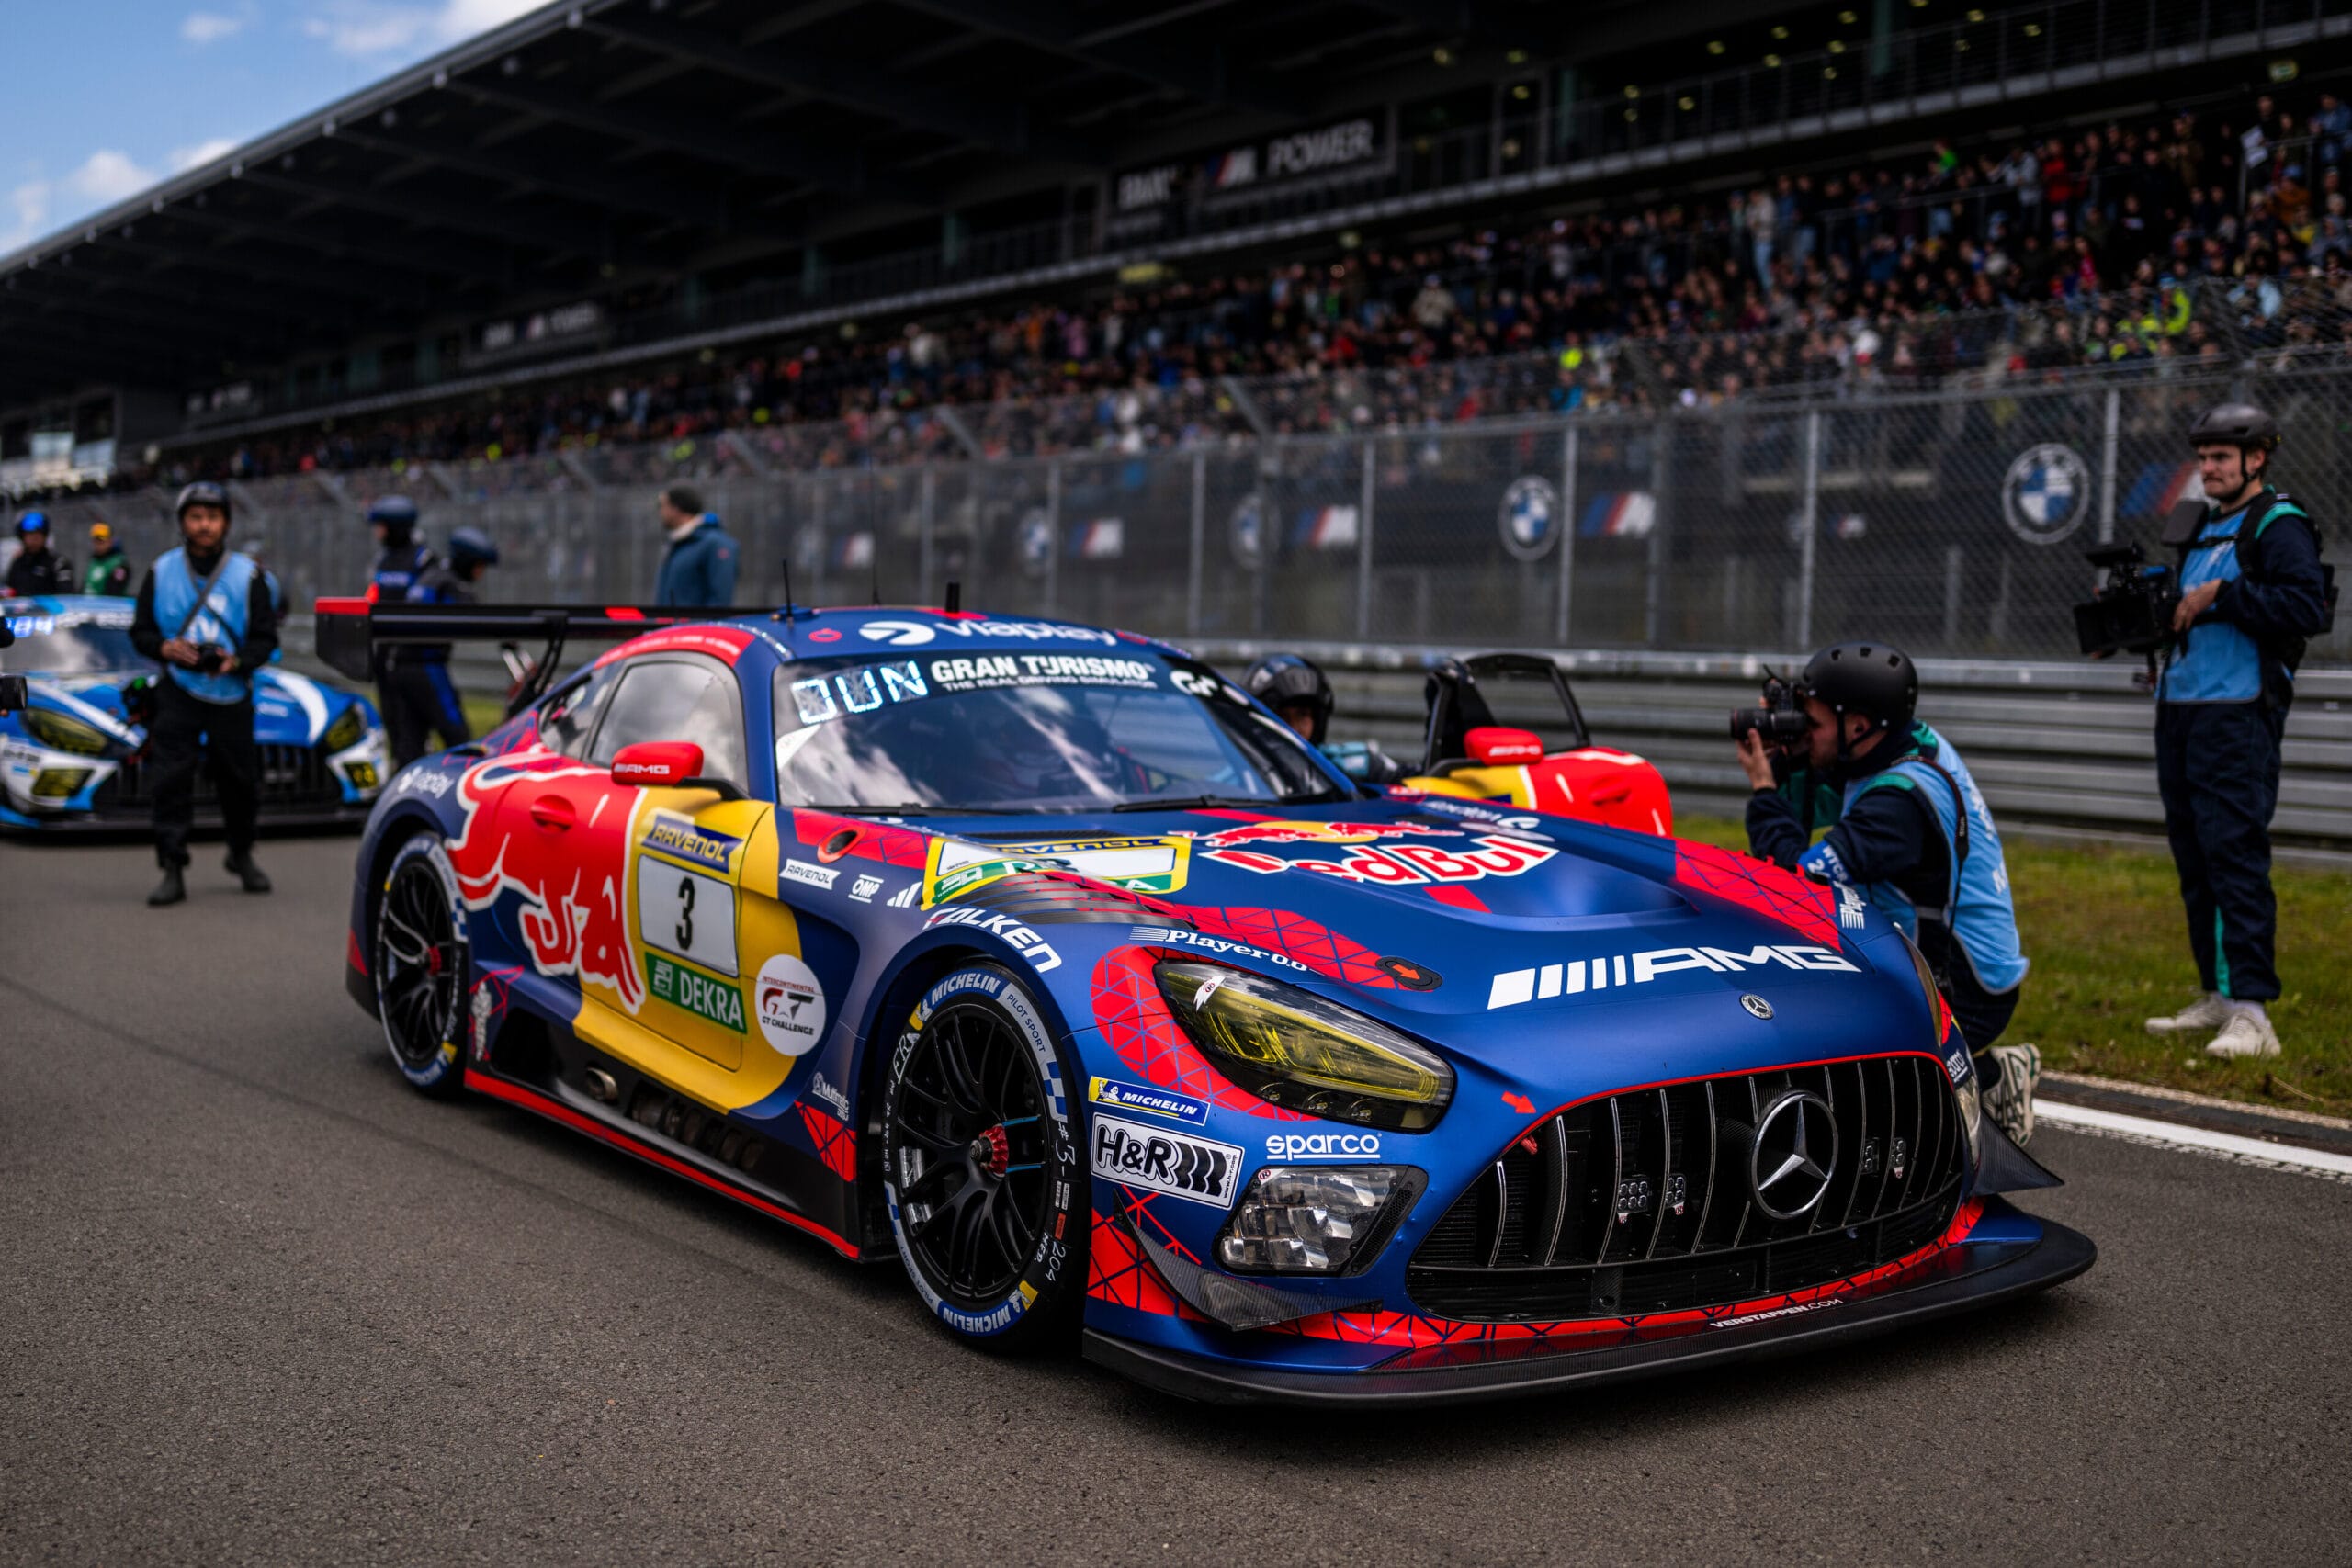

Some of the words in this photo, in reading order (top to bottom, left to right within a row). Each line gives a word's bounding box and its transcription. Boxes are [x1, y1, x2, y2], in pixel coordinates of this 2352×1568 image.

[931, 656, 1019, 683] GRAN
[1020, 655, 1149, 681] TURISMO
[626, 763, 670, 775] AMG
[650, 823, 728, 863] RAVENOL
[787, 863, 830, 886] RAVENOL
[852, 879, 881, 898] OMP
[675, 876, 696, 951] 3
[922, 907, 1063, 973] FALKEN
[1166, 930, 1270, 959] Player
[1634, 945, 1862, 985] AMG
[762, 976, 816, 994] INTERCONTINENTAL
[932, 973, 1001, 1006] MICHELIN
[679, 970, 744, 1030] DEKRA
[762, 1016, 771, 1025] GT
[771, 1017, 815, 1035] CHALLENGE
[1006, 994, 1028, 1019] PILOT
[1025, 1017, 1046, 1053] SPORT
[1122, 1090, 1199, 1116] MICHELIN
[1097, 1124, 1179, 1183] H&R
[1266, 1133, 1381, 1161] sparco
[943, 1306, 1012, 1333] MICHELIN
[1710, 1298, 1844, 1329] VERSTAPPEN.COM
